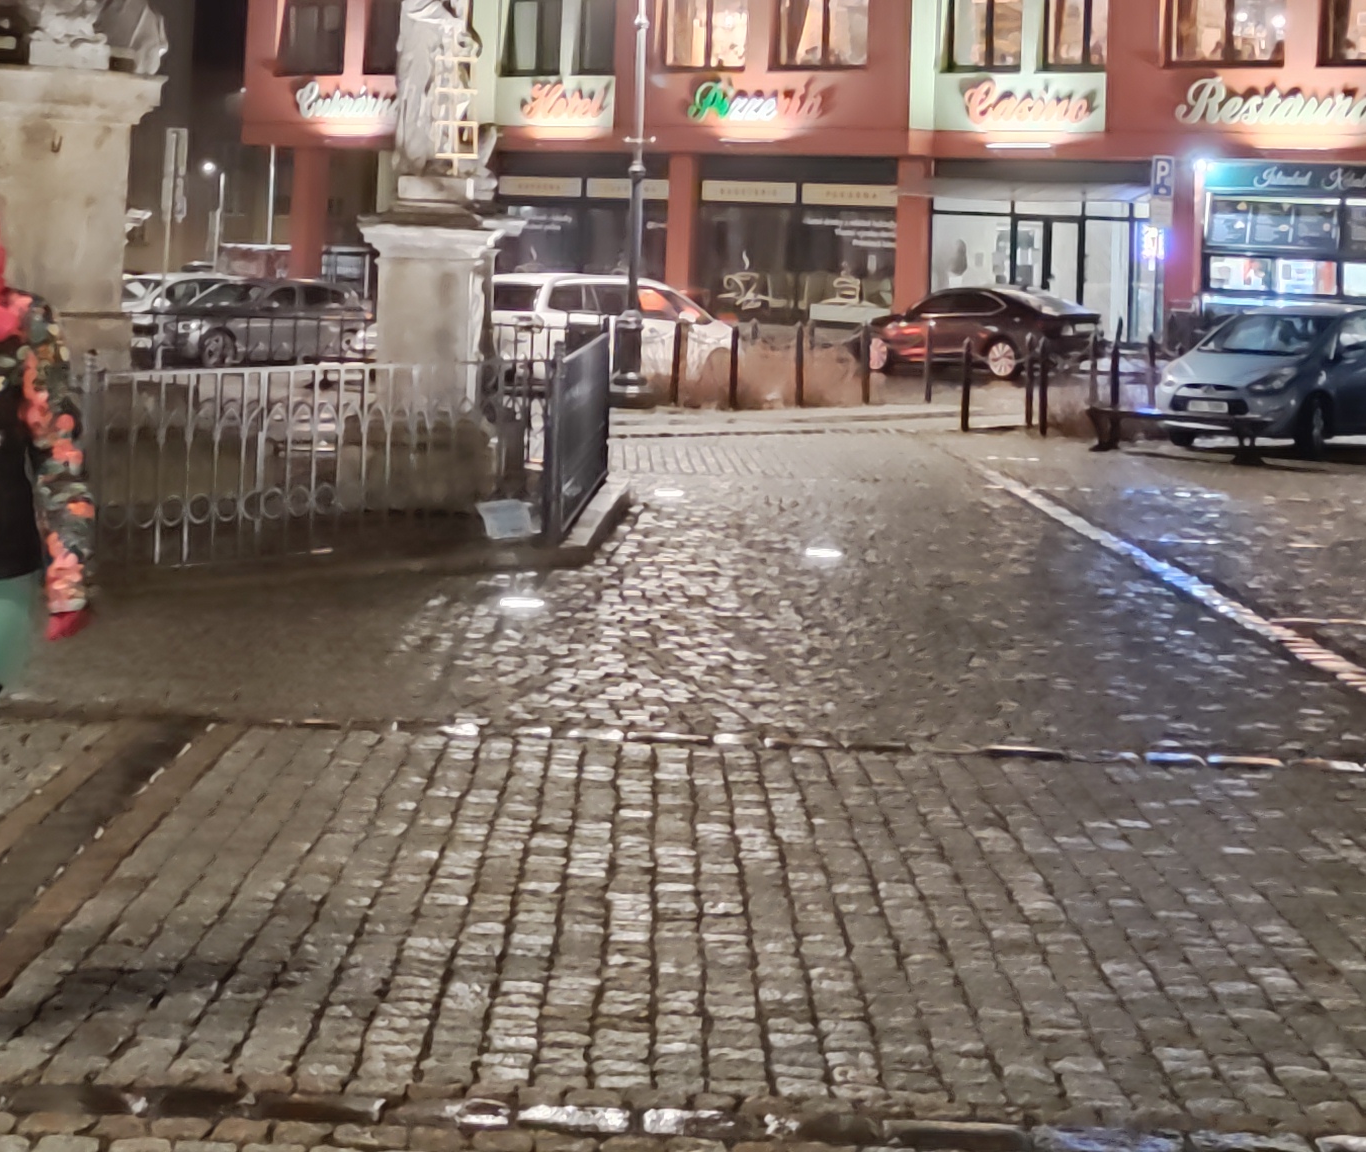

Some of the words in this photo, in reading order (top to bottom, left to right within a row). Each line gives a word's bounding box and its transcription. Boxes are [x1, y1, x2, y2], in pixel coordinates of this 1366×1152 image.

[521, 82, 606, 119] Hotel
[687, 81, 823, 122] Pizzeria
[964, 79, 1092, 124] Casino
[1156, 160, 1170, 185] P
